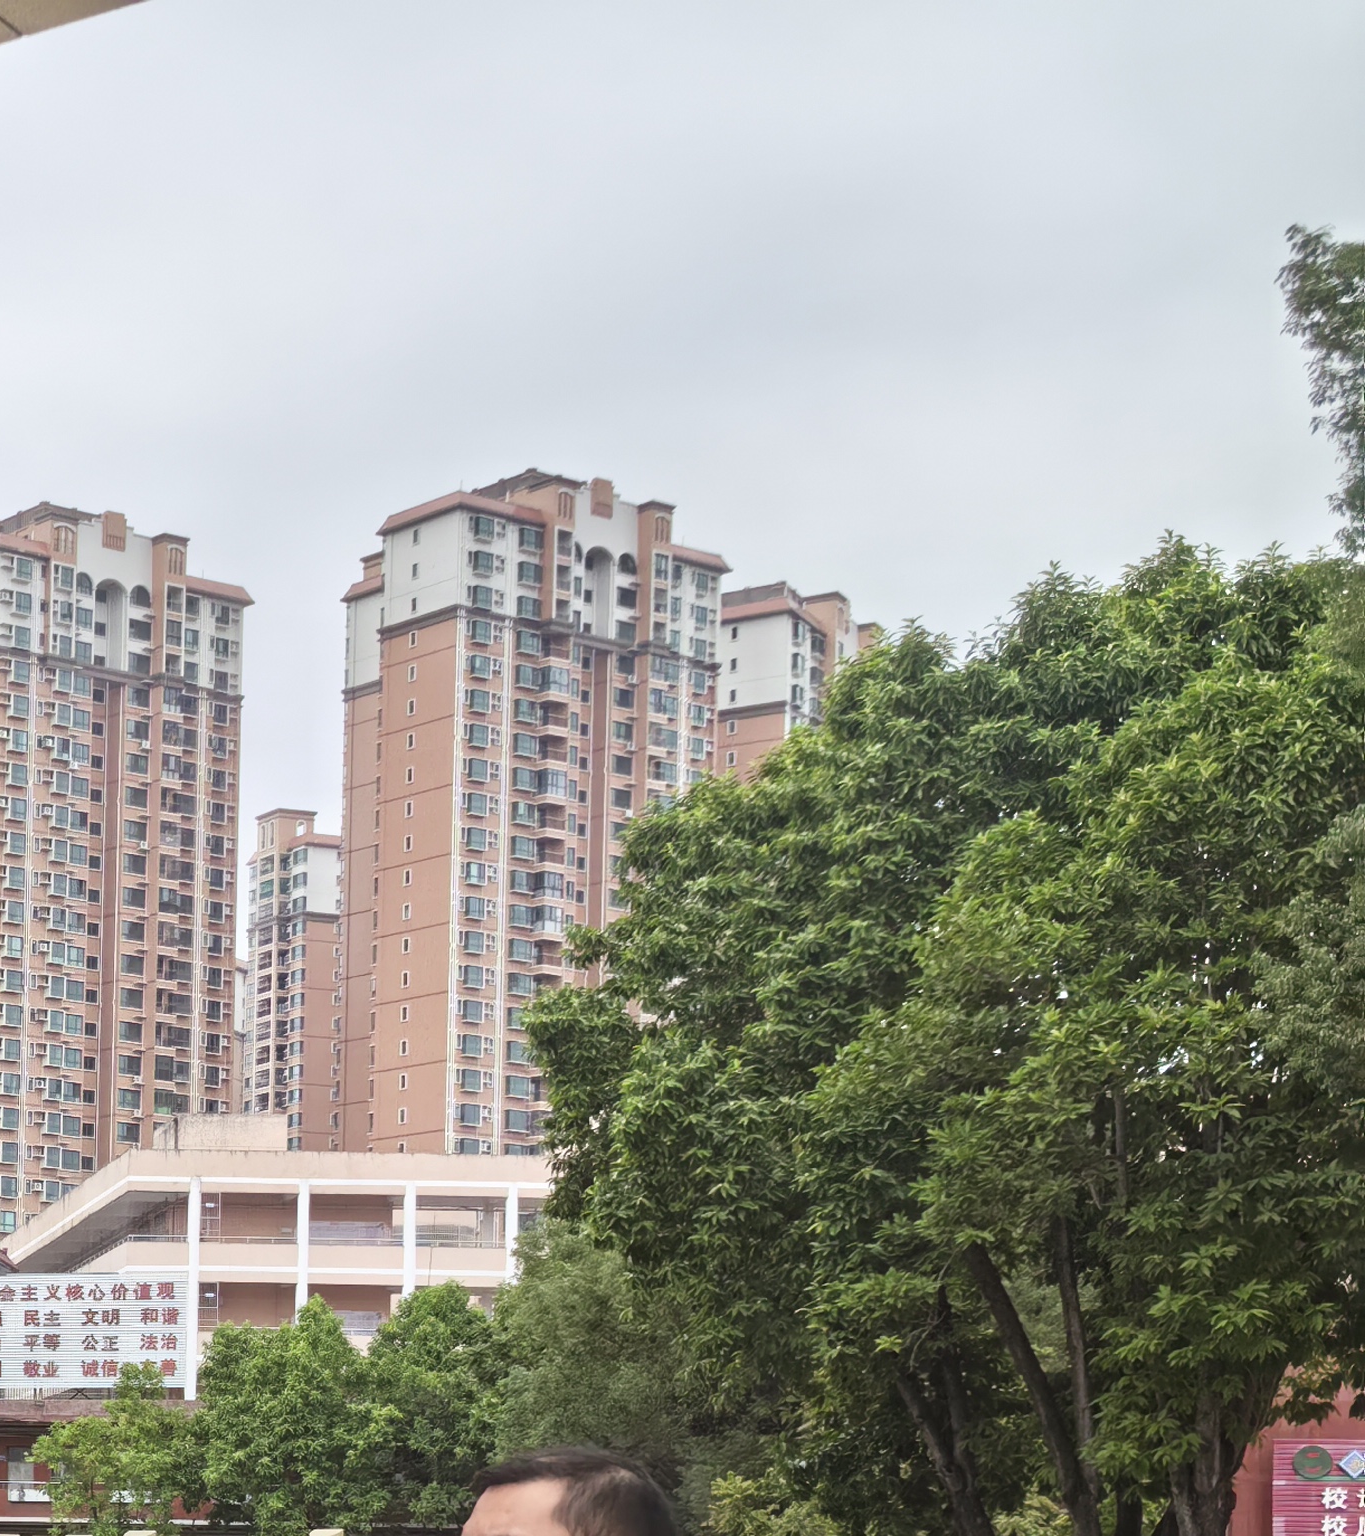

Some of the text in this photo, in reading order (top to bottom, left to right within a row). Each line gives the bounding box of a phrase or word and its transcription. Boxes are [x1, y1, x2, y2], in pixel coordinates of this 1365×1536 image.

[23, 1309, 62, 1327] 民主
[81, 1308, 120, 1326] 文明
[140, 1307, 179, 1326] 和谐
[22, 1333, 61, 1352] 平等
[81, 1333, 120, 1351] 公正
[139, 1332, 179, 1351] 法治
[23, 1359, 60, 1378] 敬业
[81, 1358, 119, 1378] 诚信
